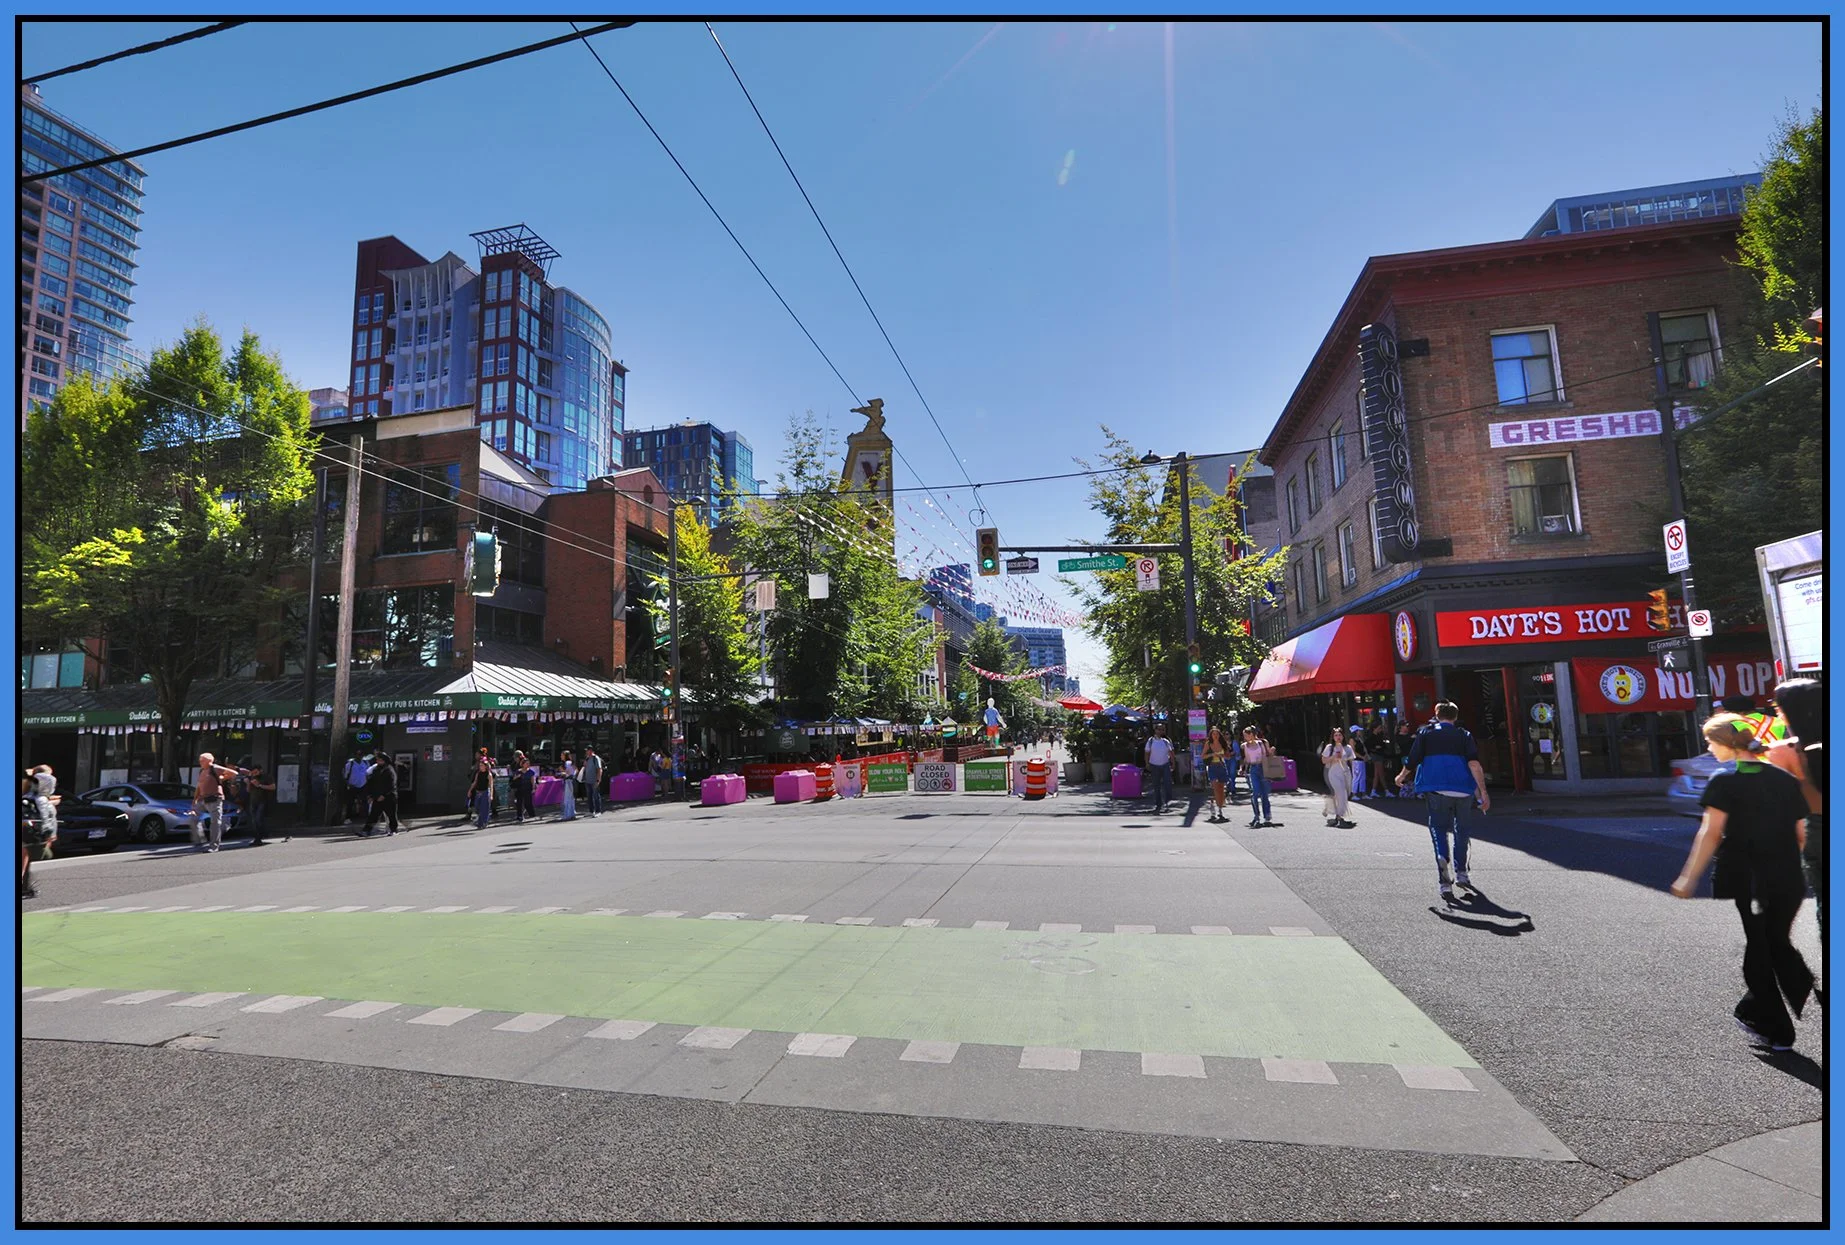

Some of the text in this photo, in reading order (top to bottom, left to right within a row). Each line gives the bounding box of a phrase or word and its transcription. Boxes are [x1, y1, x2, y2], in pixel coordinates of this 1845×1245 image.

[1670, 552, 1685, 561] EXCEPT
[1077, 558, 1119, 570] Smithe St.
[1669, 559, 1688, 569] BICYCLES
[1795, 579, 1822, 590] Come dri
[1469, 611, 1562, 639] DAVE'S
[1574, 607, 1631, 634] HOT
[1736, 663, 1773, 697] OP
[373, 699, 440, 709] PARTY PUB & KITCHEN
[497, 696, 539, 708] Dublin Calling
[578, 700, 593, 708] Dublin
[594, 701, 610, 711] Calling
[129, 711, 150, 720] Dublin
[205, 709, 217, 717] PUB
[223, 708, 246, 716] KITCHEN
[40, 716, 50, 724] PUB
